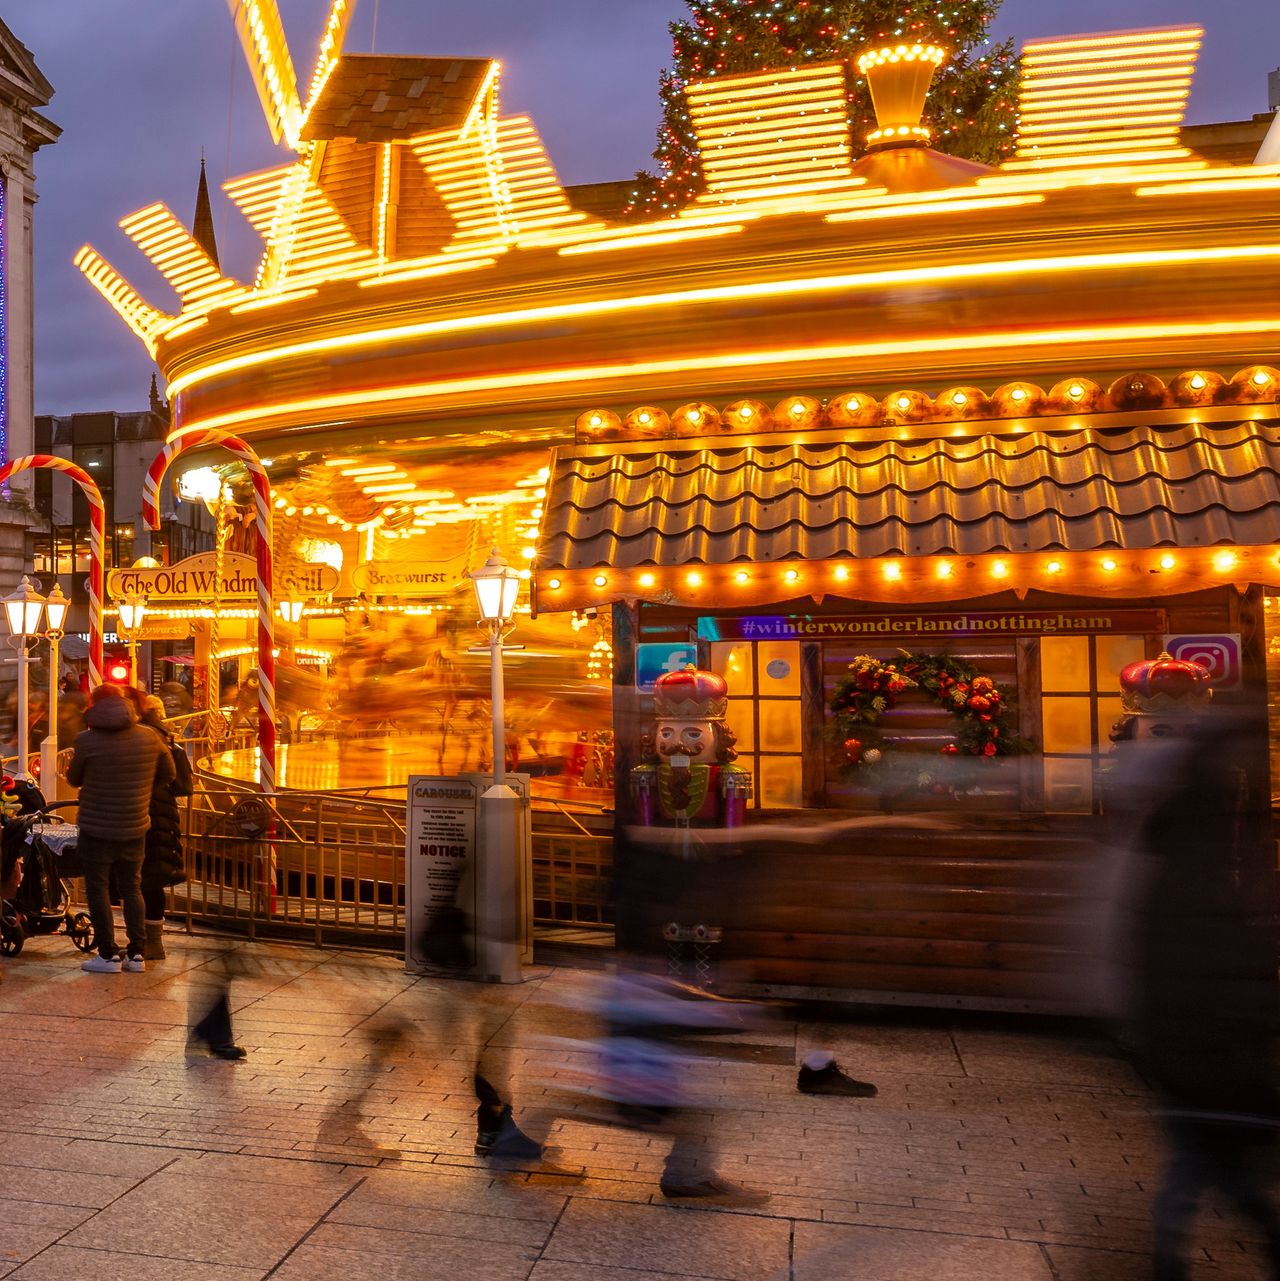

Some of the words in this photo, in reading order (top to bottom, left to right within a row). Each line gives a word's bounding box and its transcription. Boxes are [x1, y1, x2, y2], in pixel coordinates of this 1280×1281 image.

[121, 572, 153, 594] The
[155, 571, 188, 594] Old
[190, 570, 258, 594] Windm
[368, 570, 447, 585] Bratwurst
[742, 613, 1113, 635] #winterwonderlandnottingham
[415, 787, 474, 800] CAROUSEL
[420, 843, 467, 858] NOTICE
